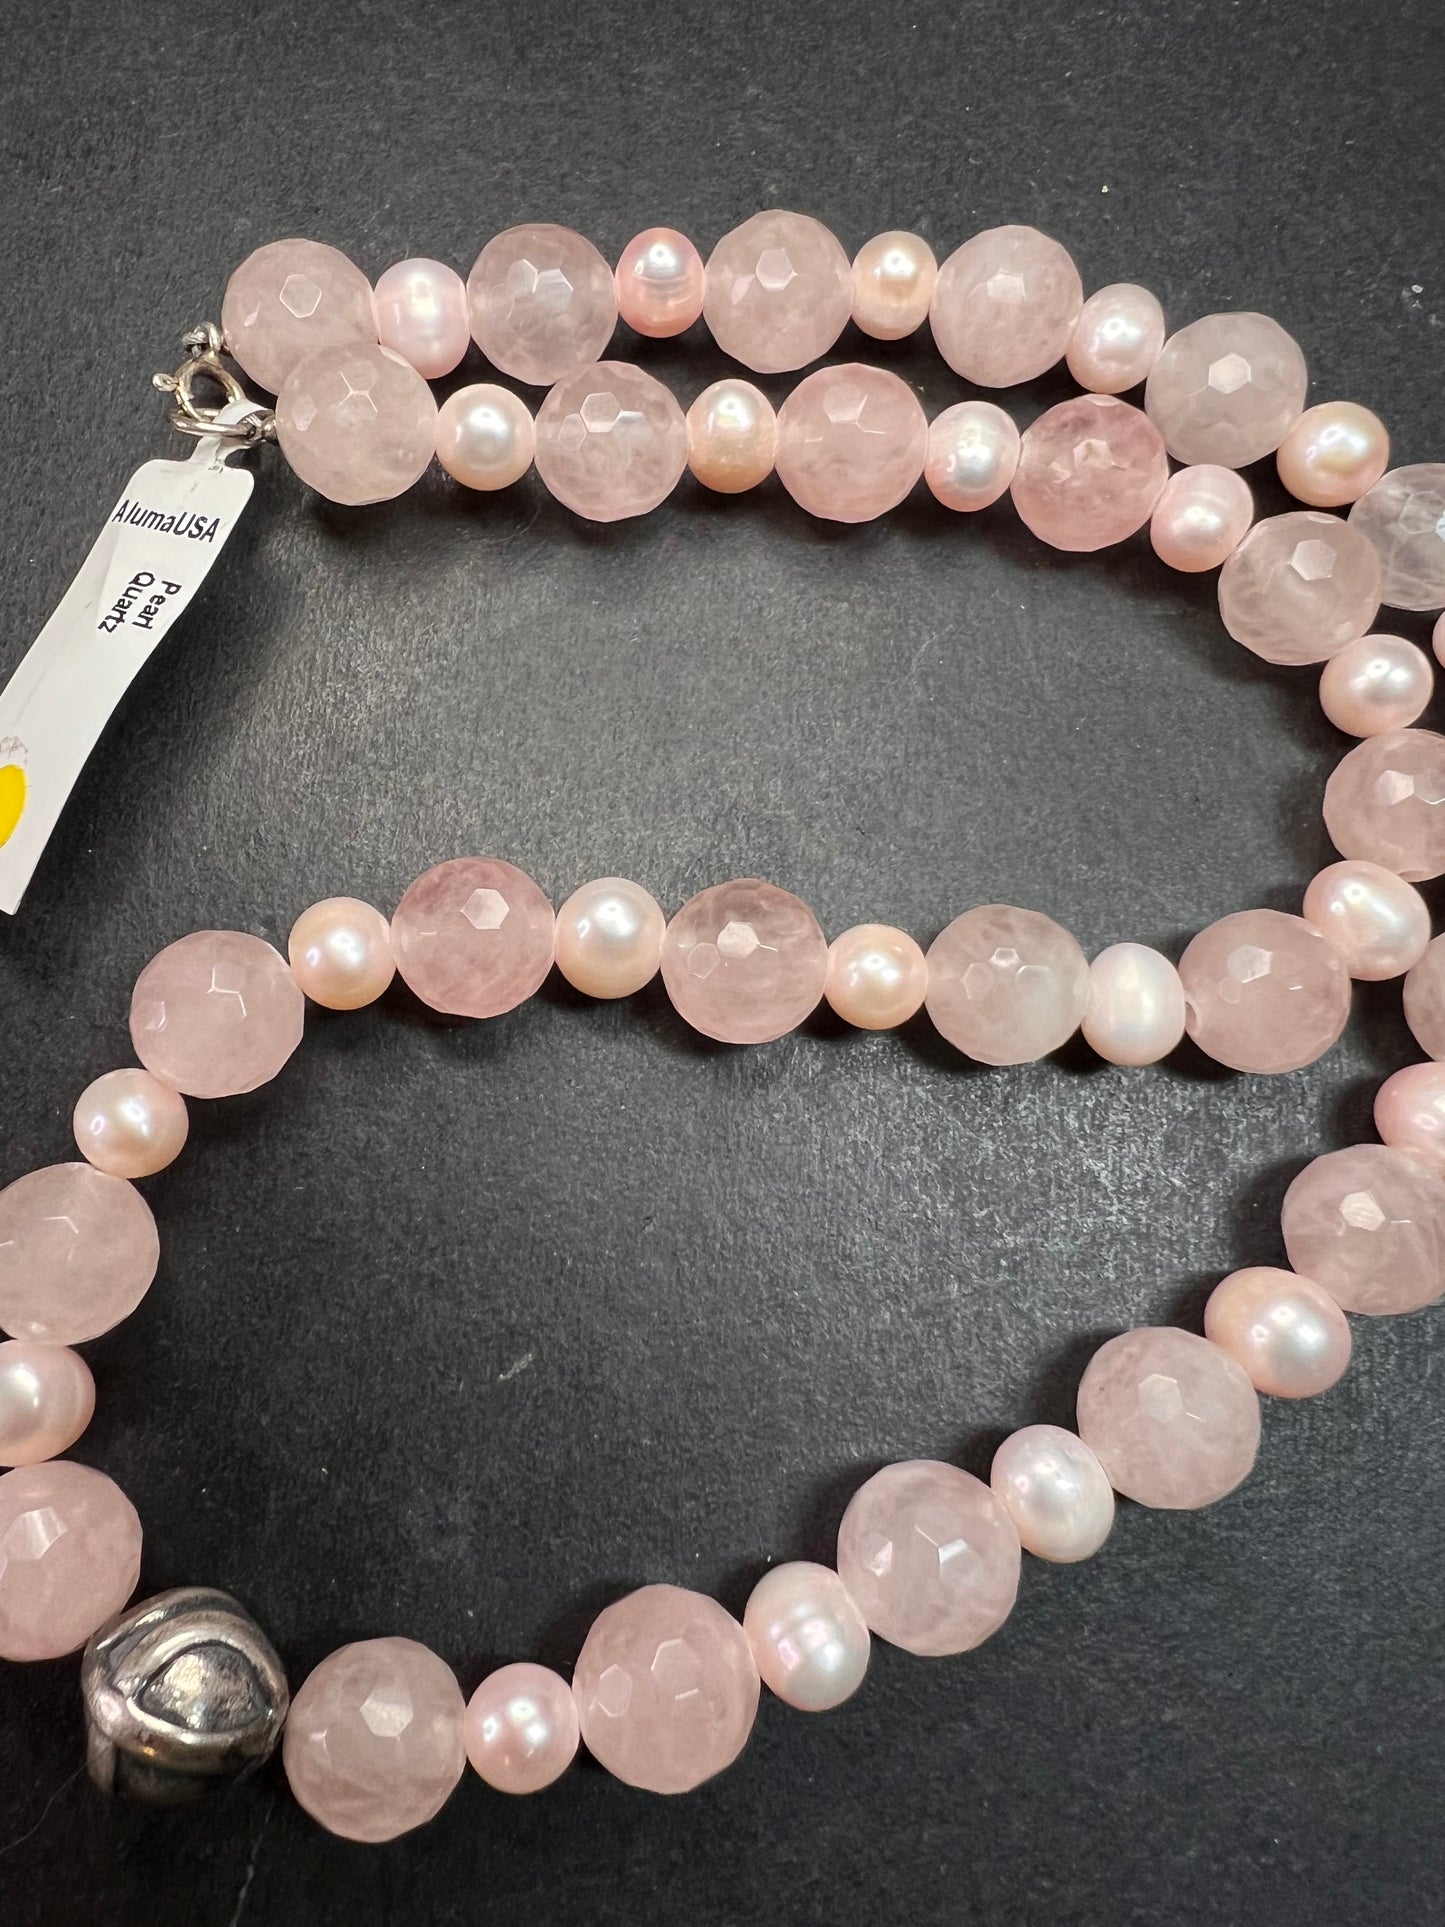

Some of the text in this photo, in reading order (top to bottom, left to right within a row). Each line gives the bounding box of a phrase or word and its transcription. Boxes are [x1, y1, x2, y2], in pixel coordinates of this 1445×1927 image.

[112, 499, 220, 543] AlumaUSA
[97, 571, 156, 633] Quartz
[132, 580, 182, 630] Pearl
